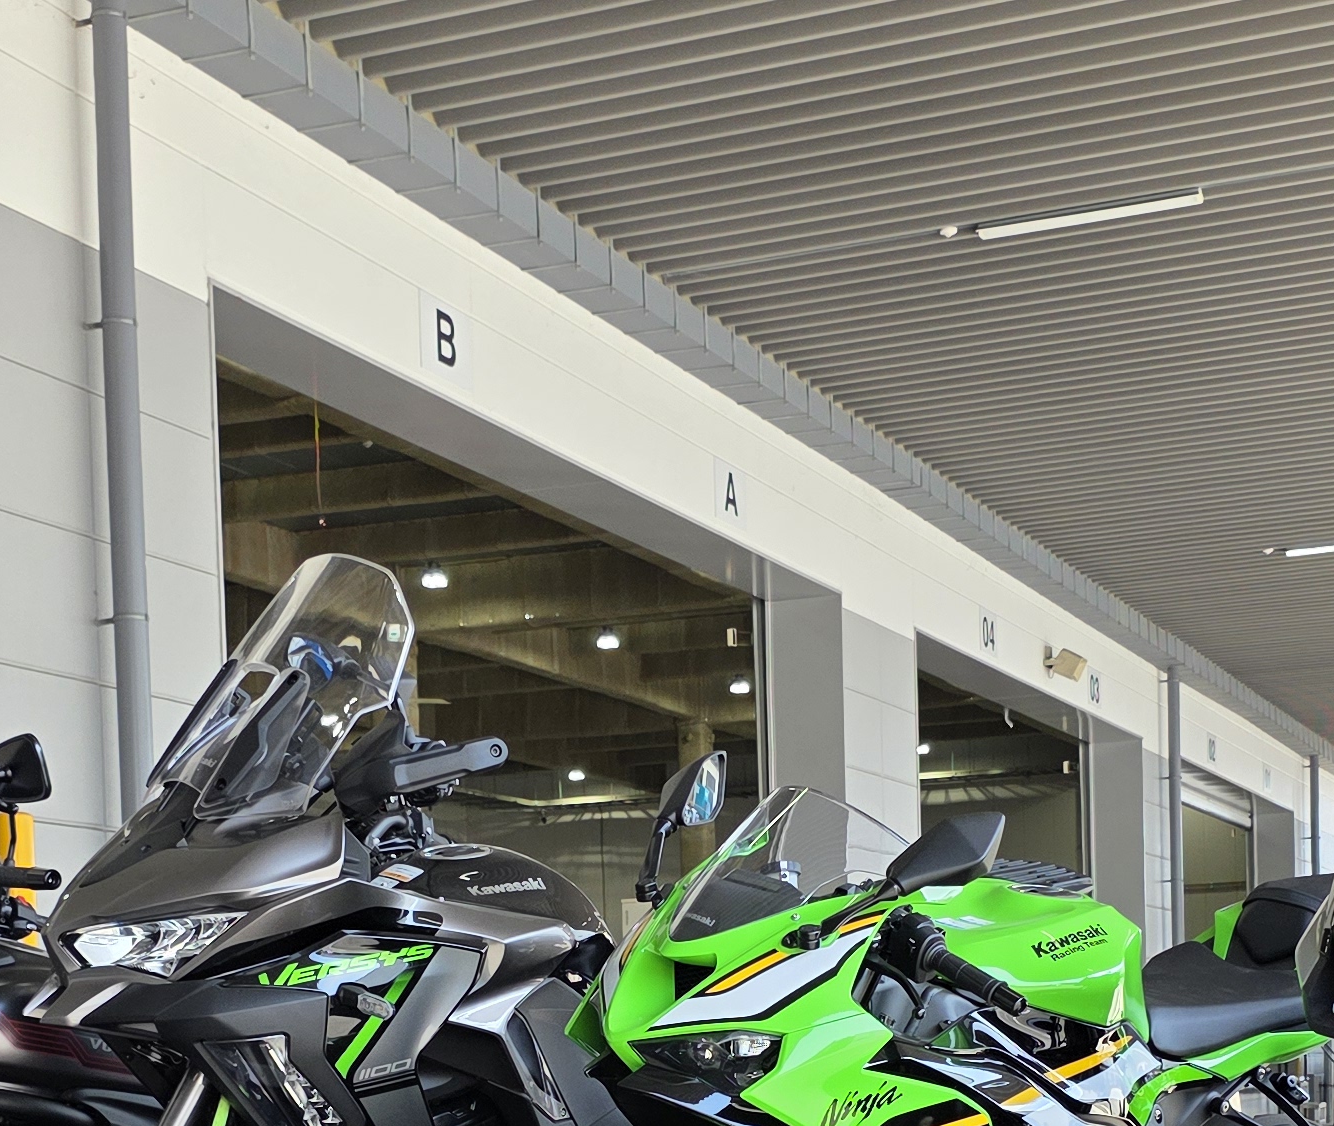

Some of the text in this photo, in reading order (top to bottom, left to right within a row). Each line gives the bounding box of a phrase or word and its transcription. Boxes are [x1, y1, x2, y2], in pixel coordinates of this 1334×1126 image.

[437, 309, 456, 367] B
[724, 472, 739, 517] A
[982, 616, 995, 651] 04
[1089, 674, 1100, 703] 03
[1208, 738, 1216, 762] 02
[467, 877, 547, 896] Kawasaki
[1031, 923, 1108, 958] Kawasaki
[1050, 938, 1108, 961] Racing Team
[258, 944, 435, 986] VERSYS
[359, 1058, 412, 1080] 1100
